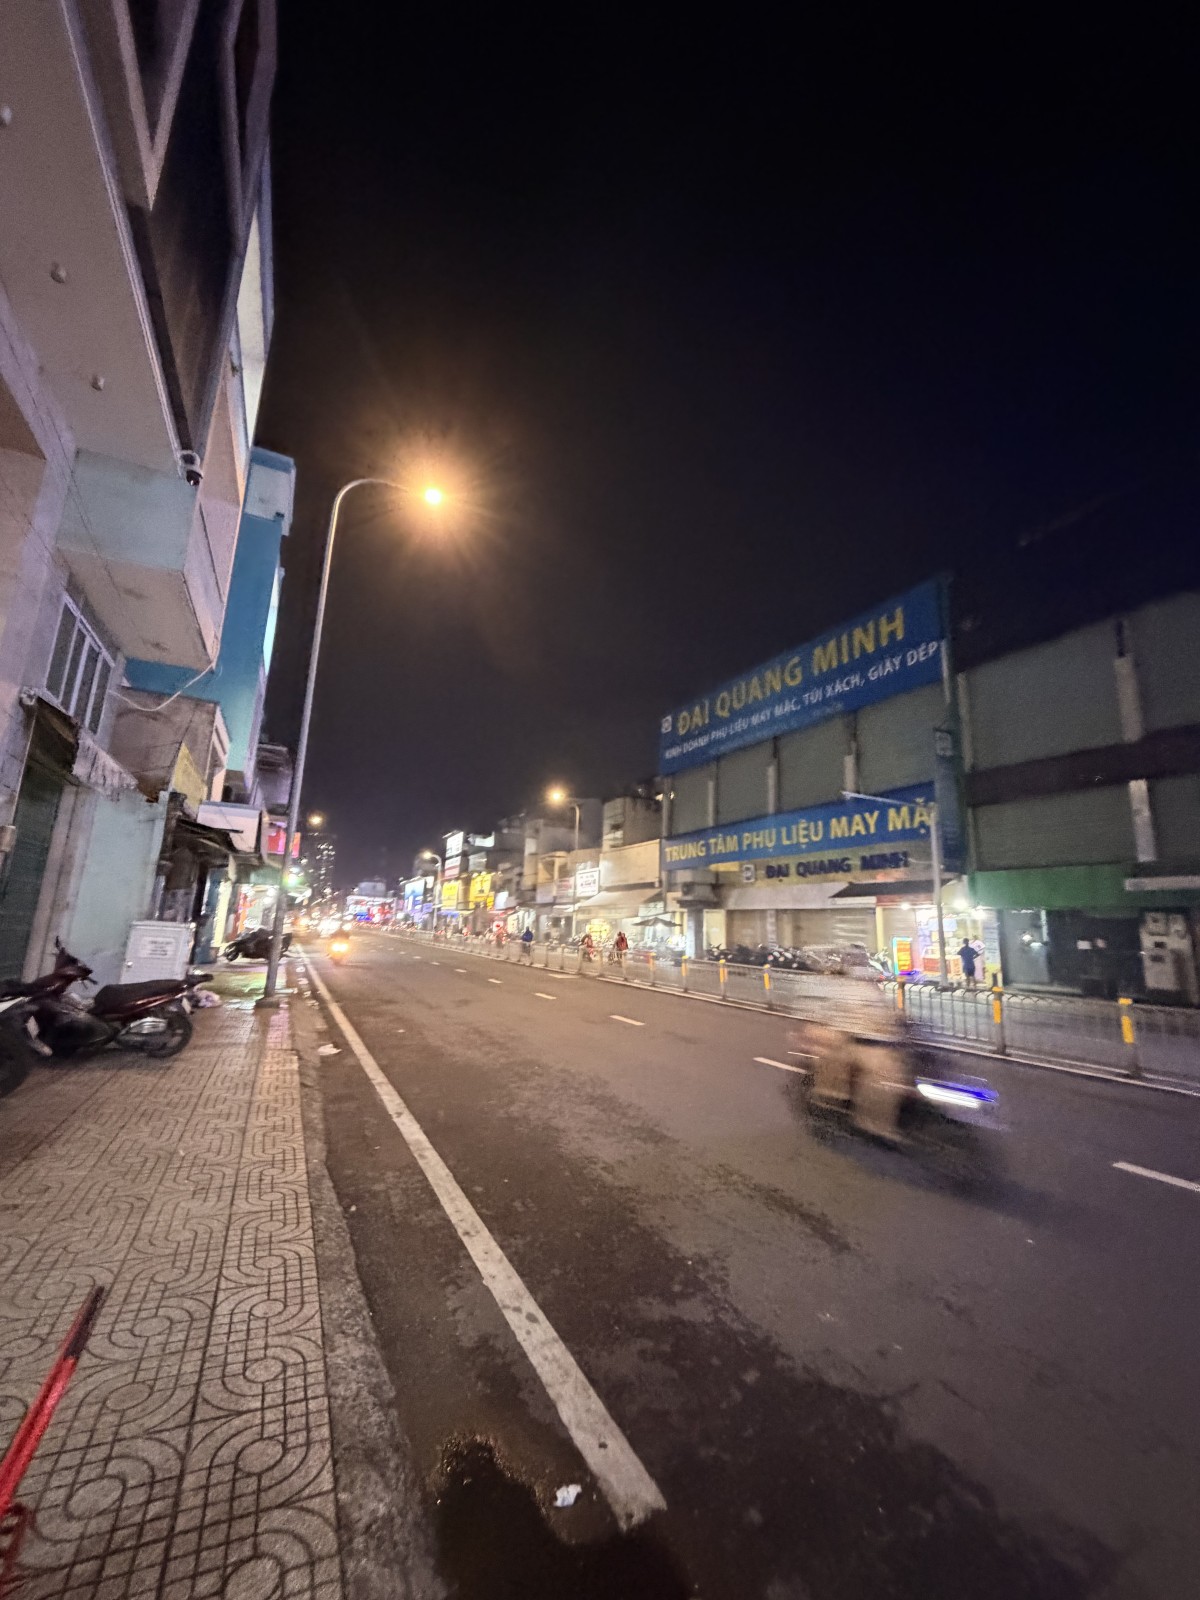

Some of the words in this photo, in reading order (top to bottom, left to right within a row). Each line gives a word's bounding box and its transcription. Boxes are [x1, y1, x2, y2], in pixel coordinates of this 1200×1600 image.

[715, 656, 803, 718] QUANG
[812, 607, 905, 676] MINH
[906, 639, 938, 667] DÉP
[664, 841, 707, 863] TRUNG
[708, 833, 739, 856] TÂM
[742, 827, 776, 853] PHỤ
[781, 818, 824, 850] LIỆU
[830, 810, 880, 840] MAY
[887, 797, 933, 834] MẶ
[796, 857, 852, 878] QUANG
[860, 850, 910, 871] MINH
